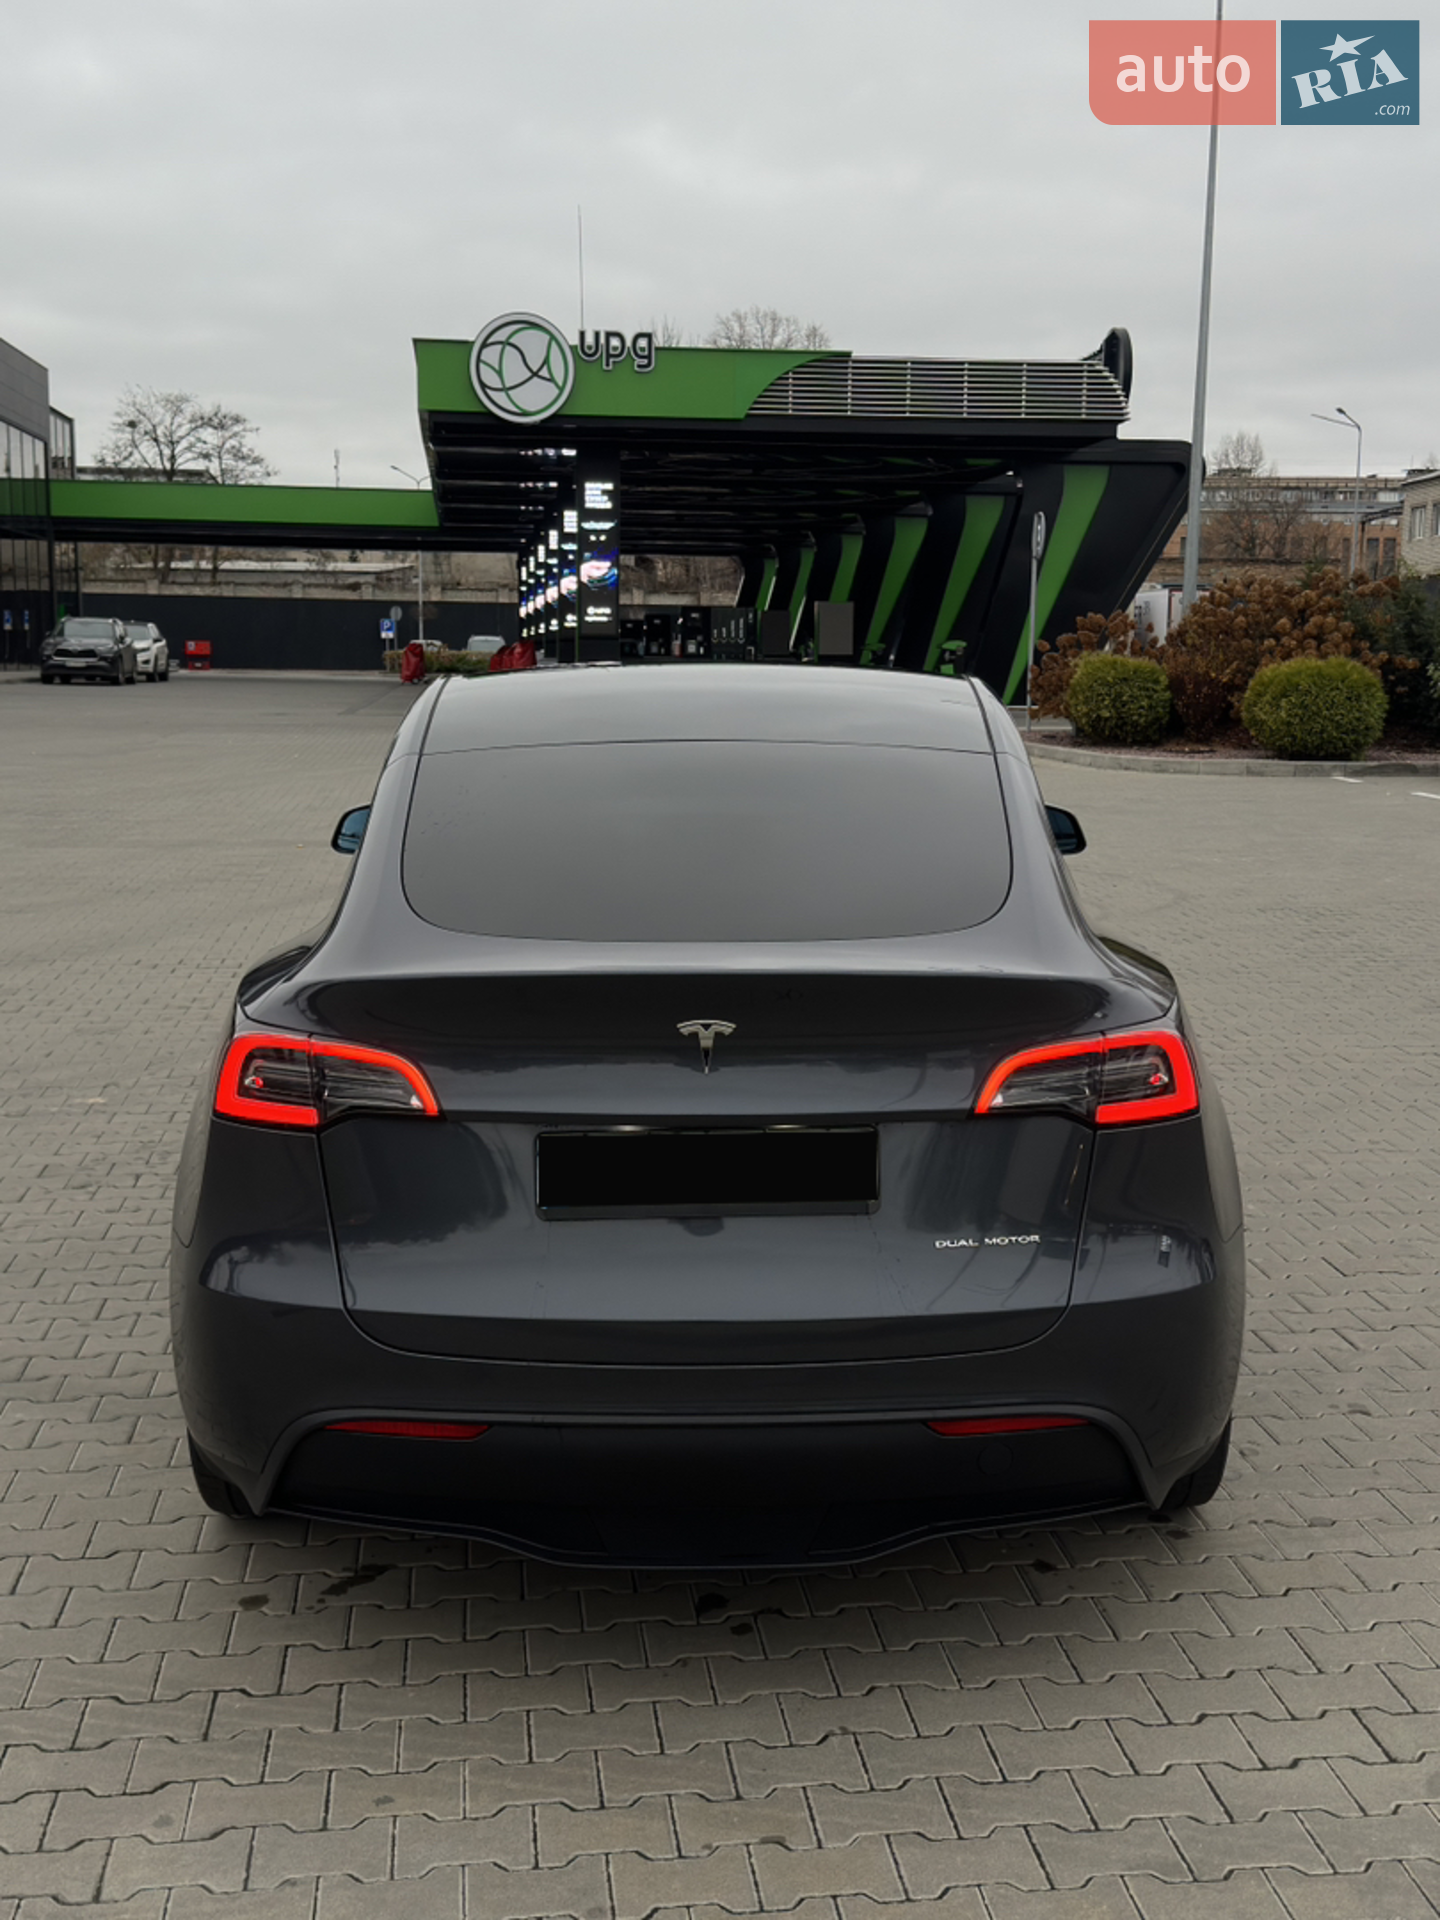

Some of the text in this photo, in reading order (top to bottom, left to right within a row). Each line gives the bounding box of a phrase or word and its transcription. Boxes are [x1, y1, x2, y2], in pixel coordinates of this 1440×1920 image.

[578, 330, 655, 372] upg
[934, 1234, 1041, 1250] DUAL MOTOR
